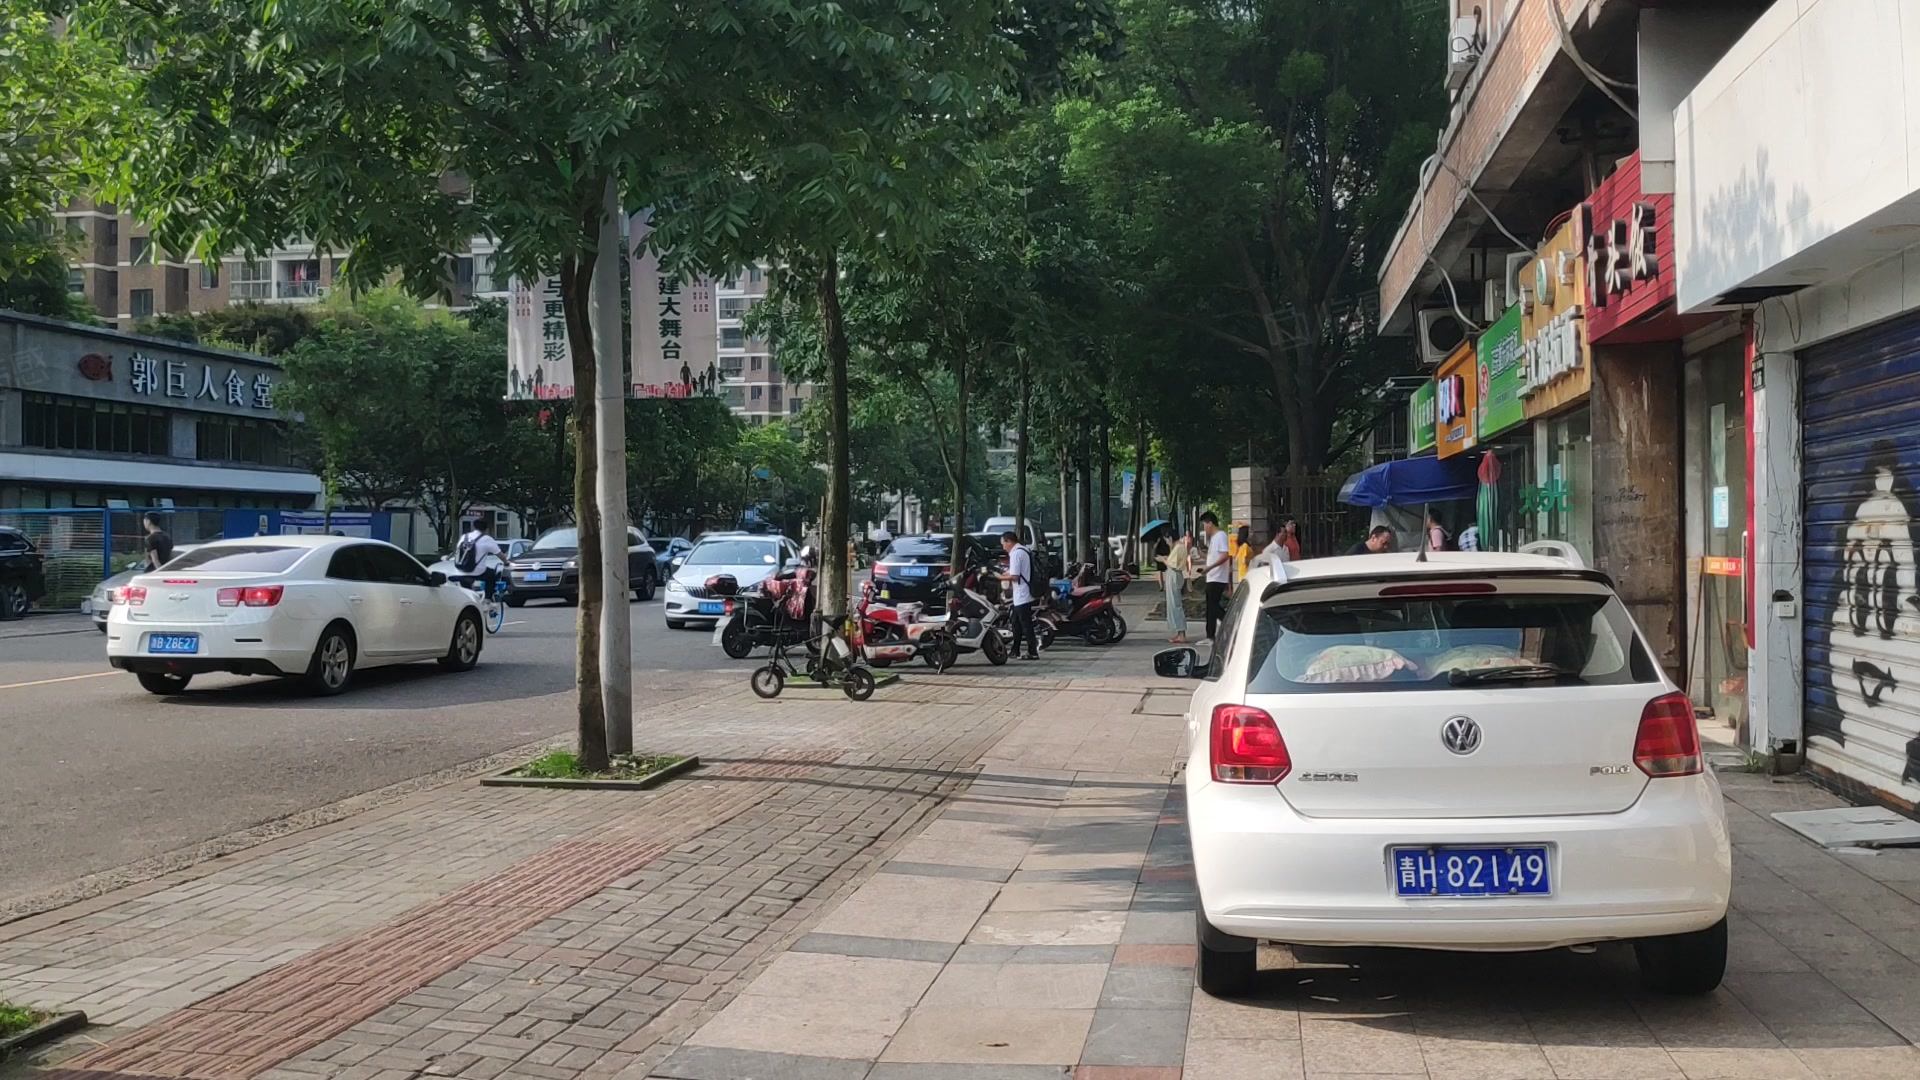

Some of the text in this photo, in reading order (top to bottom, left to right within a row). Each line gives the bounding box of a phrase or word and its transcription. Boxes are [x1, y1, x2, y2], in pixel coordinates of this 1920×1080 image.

[131, 352, 273, 409] 郭巨人食堂
